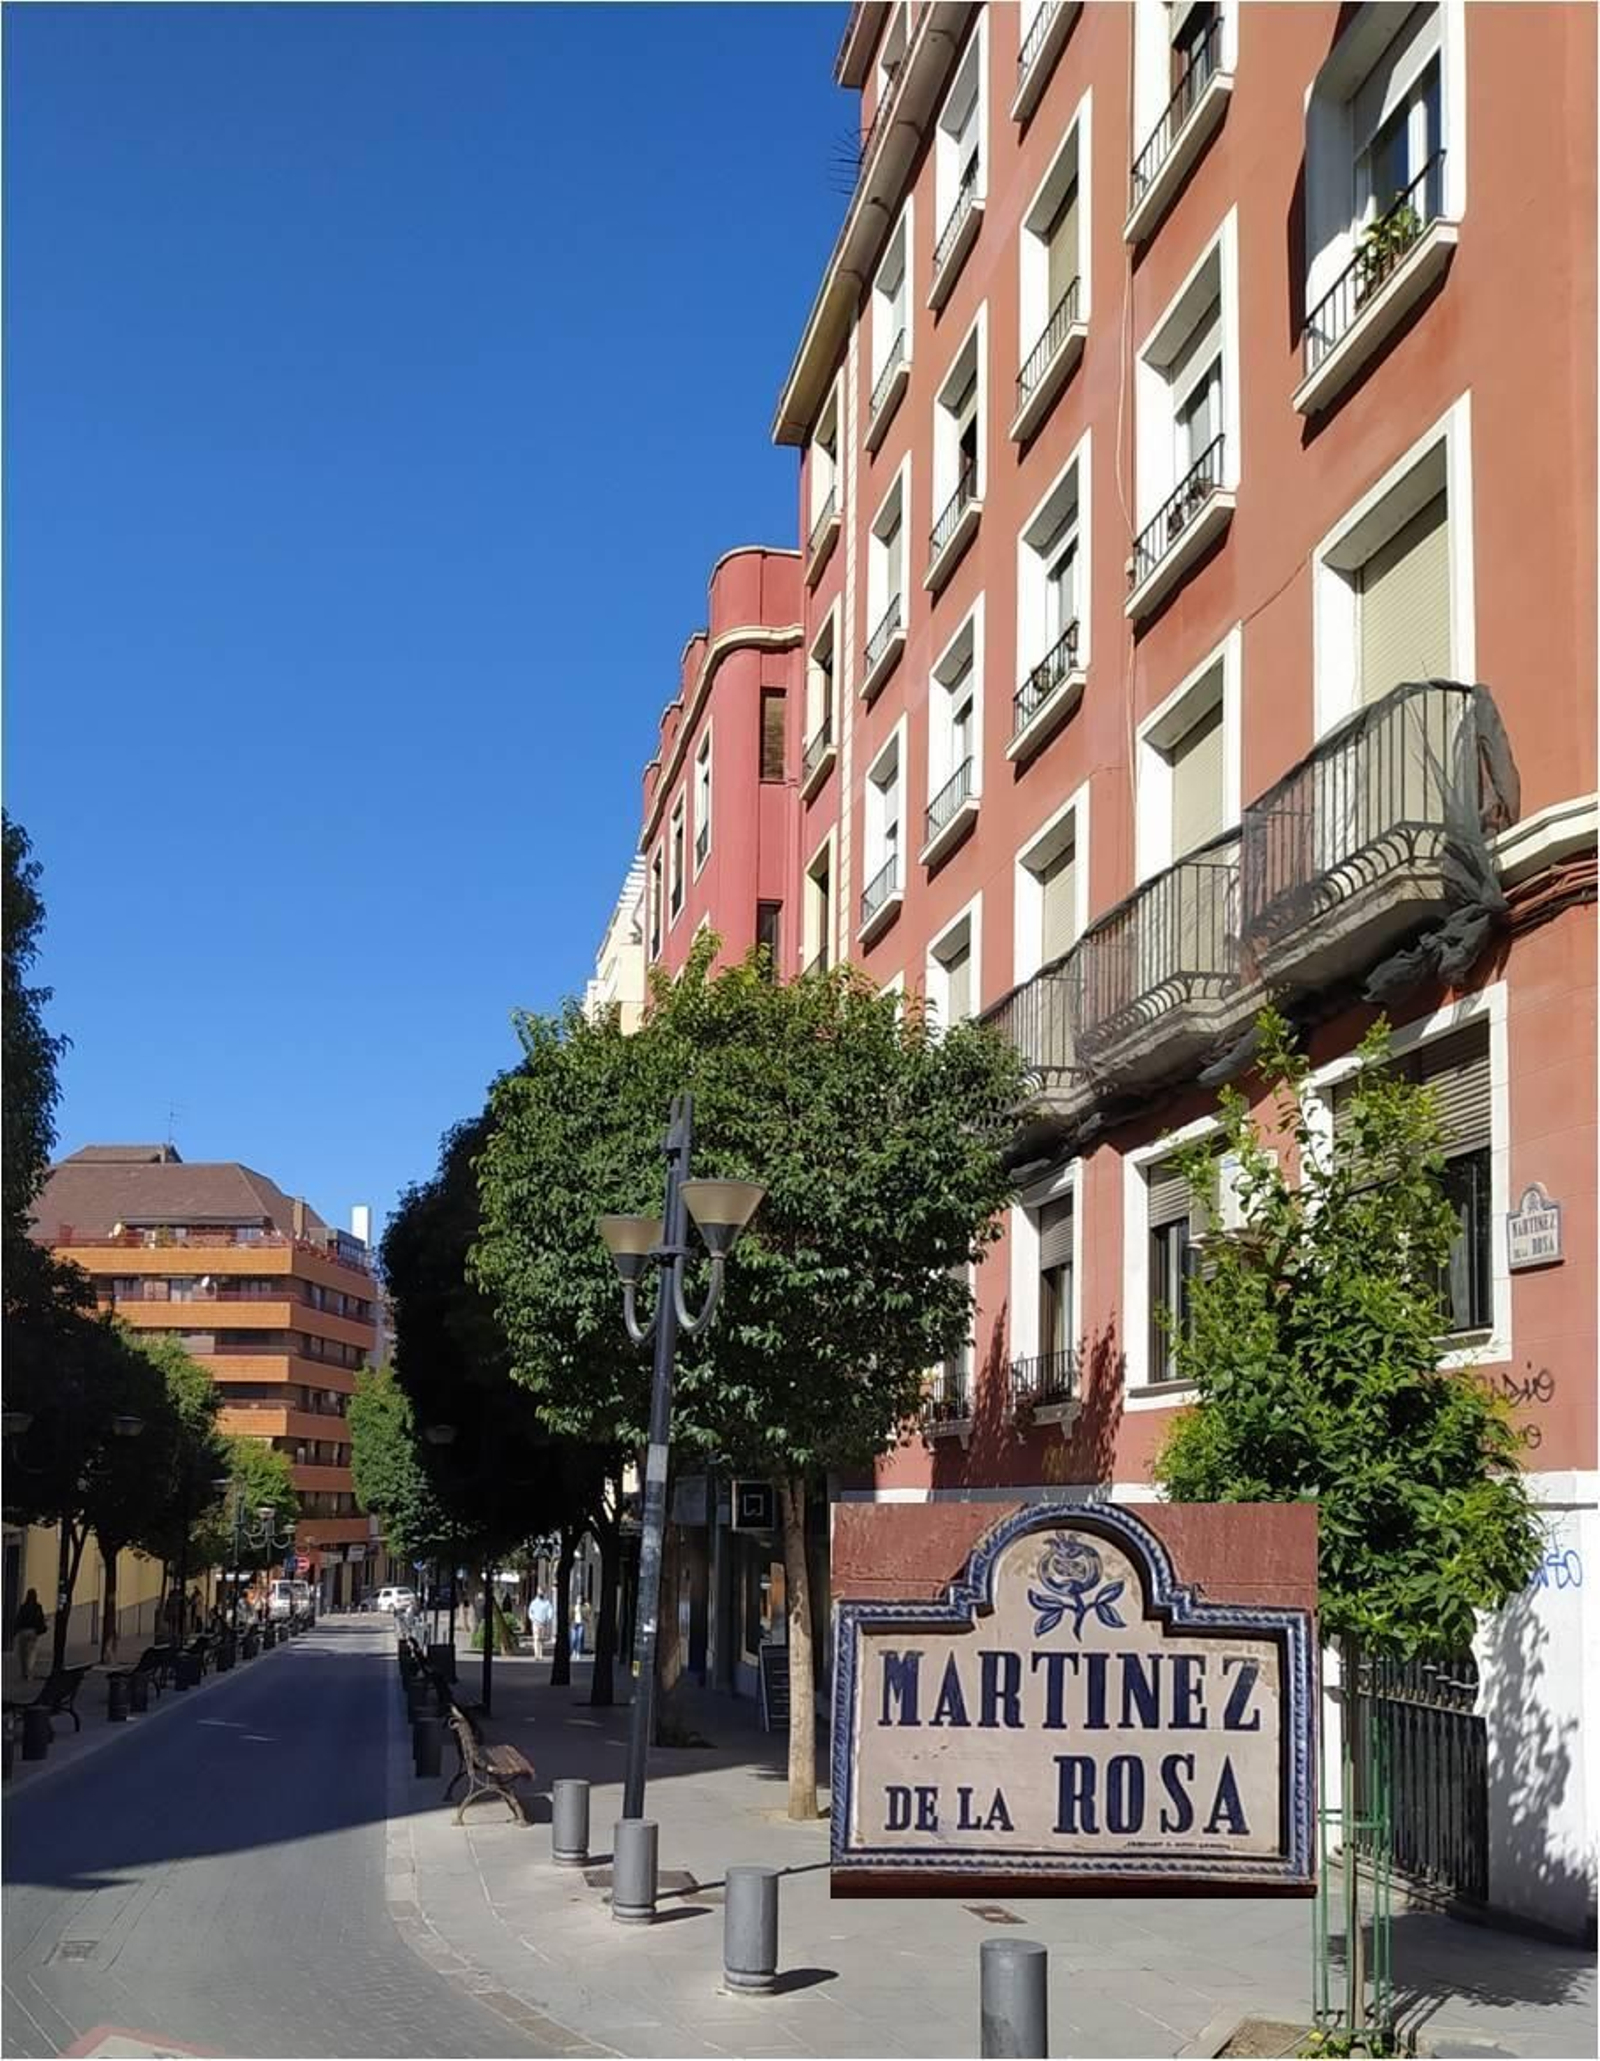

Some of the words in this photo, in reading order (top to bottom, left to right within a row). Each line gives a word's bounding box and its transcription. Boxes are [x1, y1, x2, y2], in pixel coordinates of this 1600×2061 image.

[878, 1649, 1260, 1732] MARTINEZ
[885, 1786, 939, 1831] DE
[957, 1787, 1014, 1832] LA
[1053, 1754, 1250, 1835] ROSA
